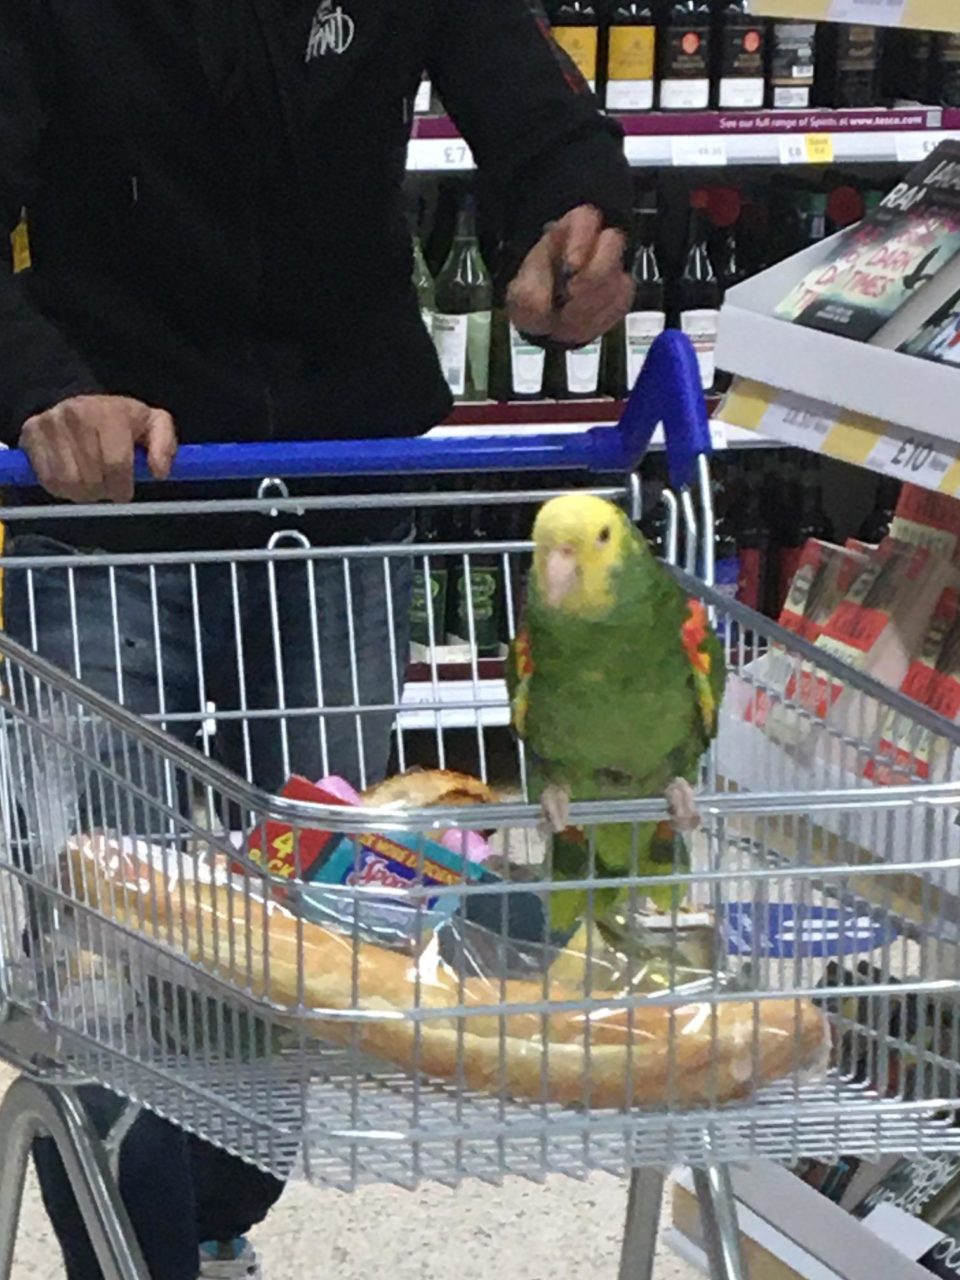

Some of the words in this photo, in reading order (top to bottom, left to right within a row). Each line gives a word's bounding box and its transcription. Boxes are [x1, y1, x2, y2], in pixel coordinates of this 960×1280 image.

[720, 118, 737, 129] See
[771, 119, 796, 129] range
[271, 830, 302, 860] 4
[248, 848, 296, 879] PCK
